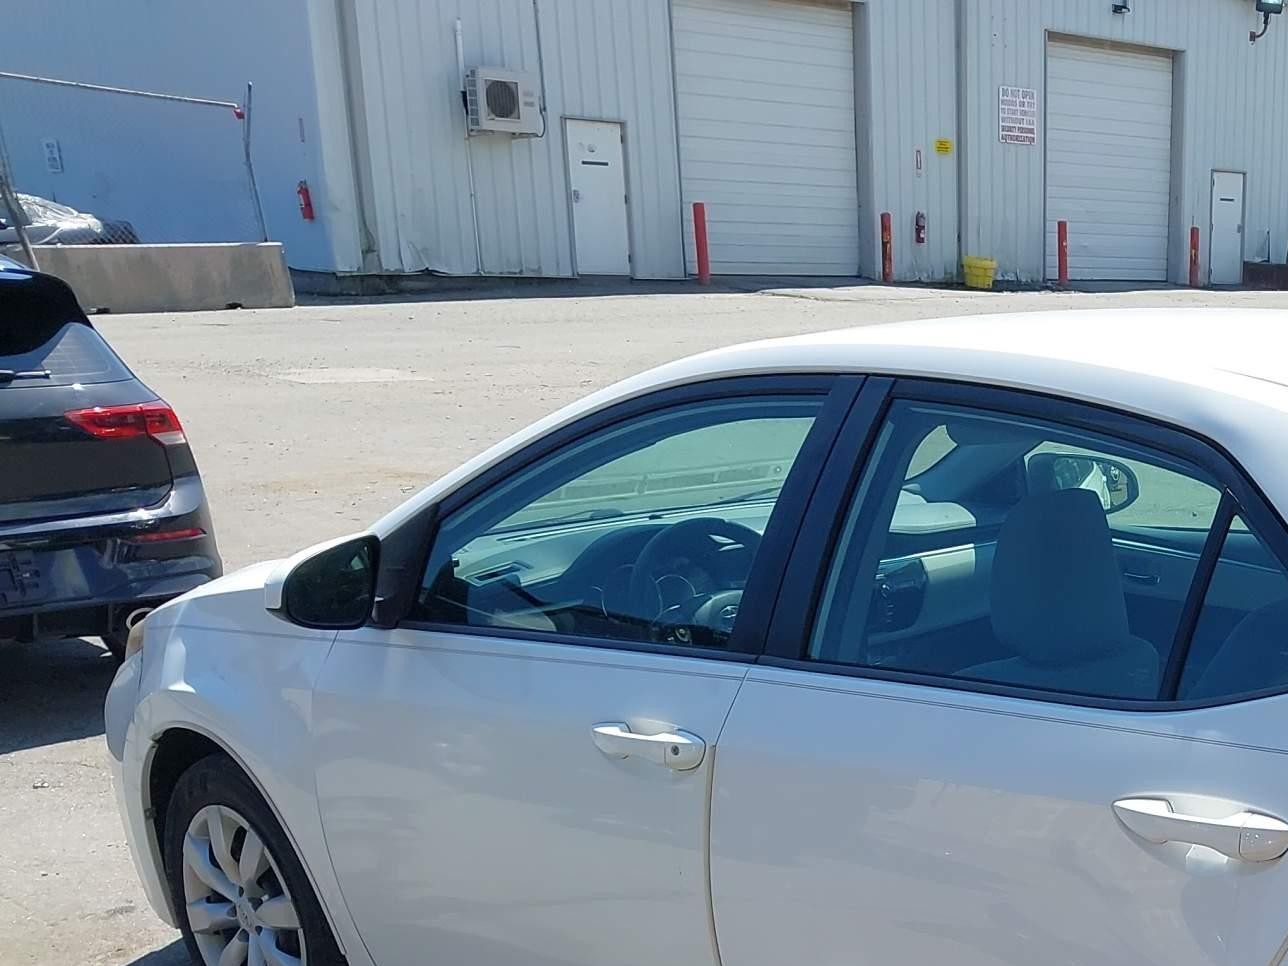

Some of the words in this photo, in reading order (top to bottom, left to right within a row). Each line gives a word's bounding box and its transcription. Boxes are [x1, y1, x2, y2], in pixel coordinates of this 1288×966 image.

[1001, 88, 1009, 98] DO
[1010, 89, 1020, 99] NOT
[1021, 90, 1034, 100] OPEN
